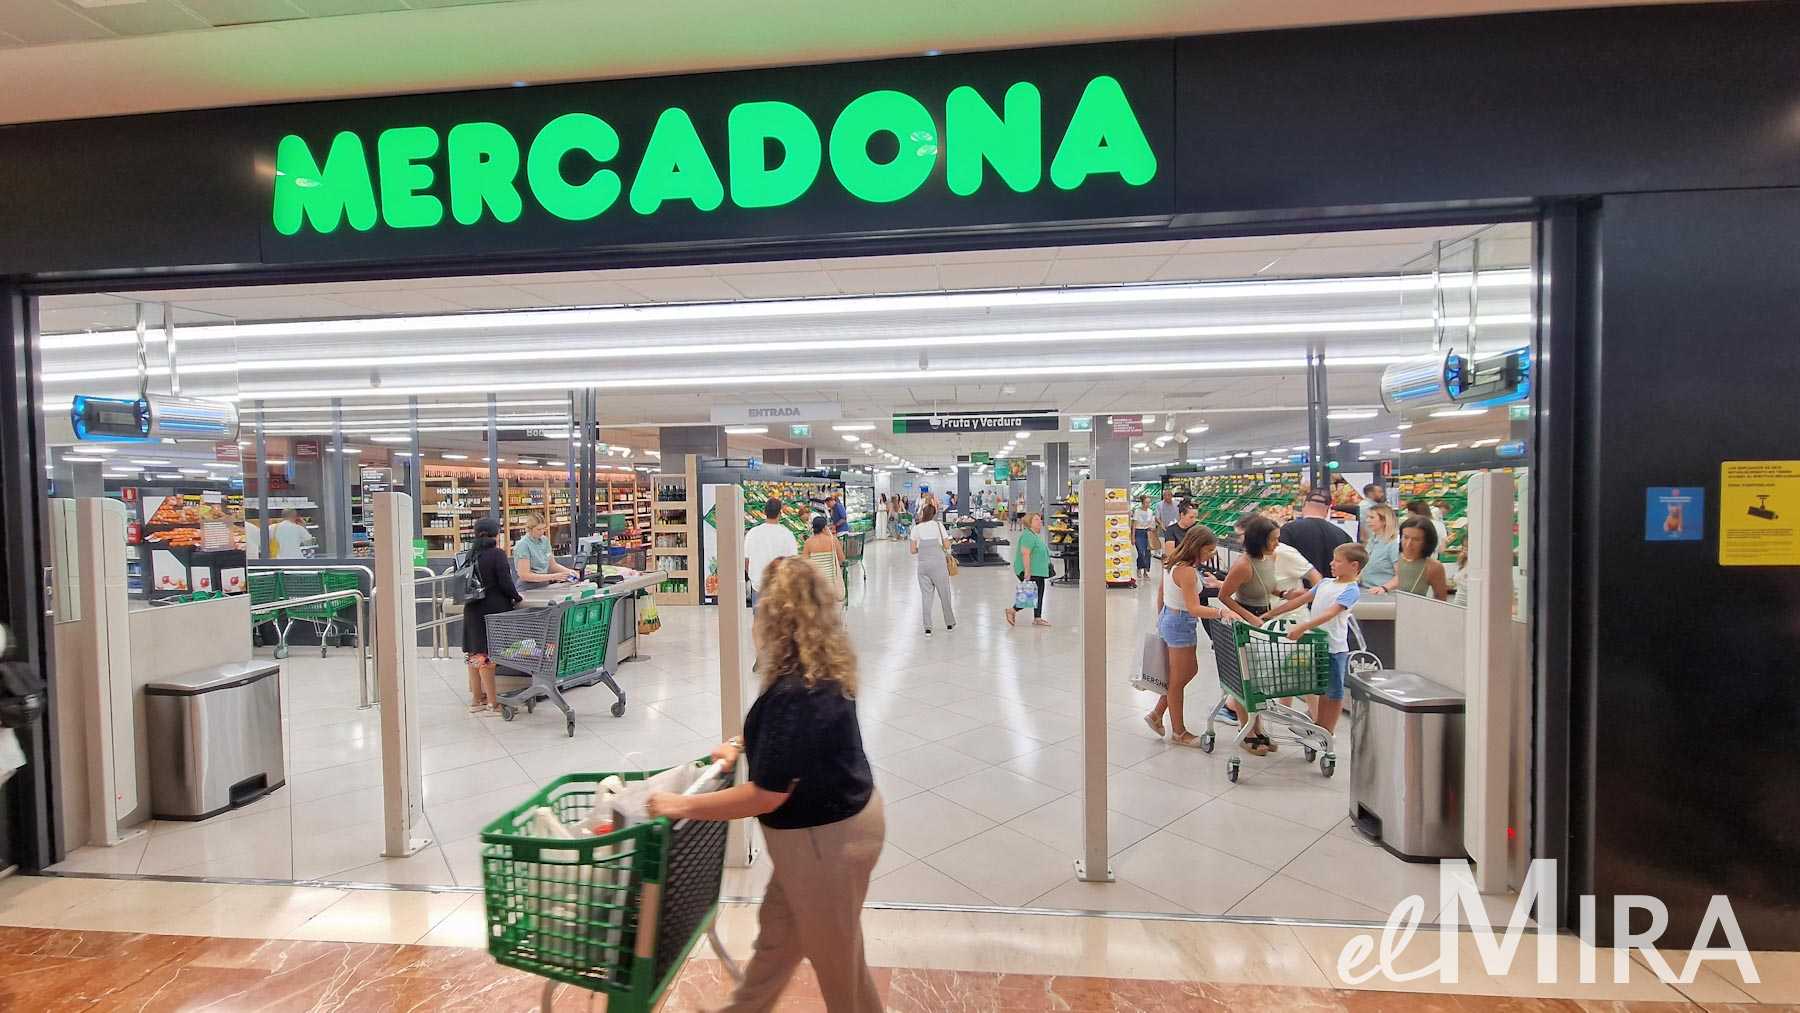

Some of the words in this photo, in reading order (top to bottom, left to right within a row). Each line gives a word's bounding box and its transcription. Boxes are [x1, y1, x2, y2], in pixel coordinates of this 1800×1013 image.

[272, 75, 1157, 236] MERCADONA
[748, 407, 800, 417] ENTRADA
[942, 418, 970, 428] Fruta
[972, 419, 979, 430] y
[980, 417, 1022, 427] Verdura
[436, 487, 468, 495] HORARIO
[1142, 673, 1168, 690] BERSHK
